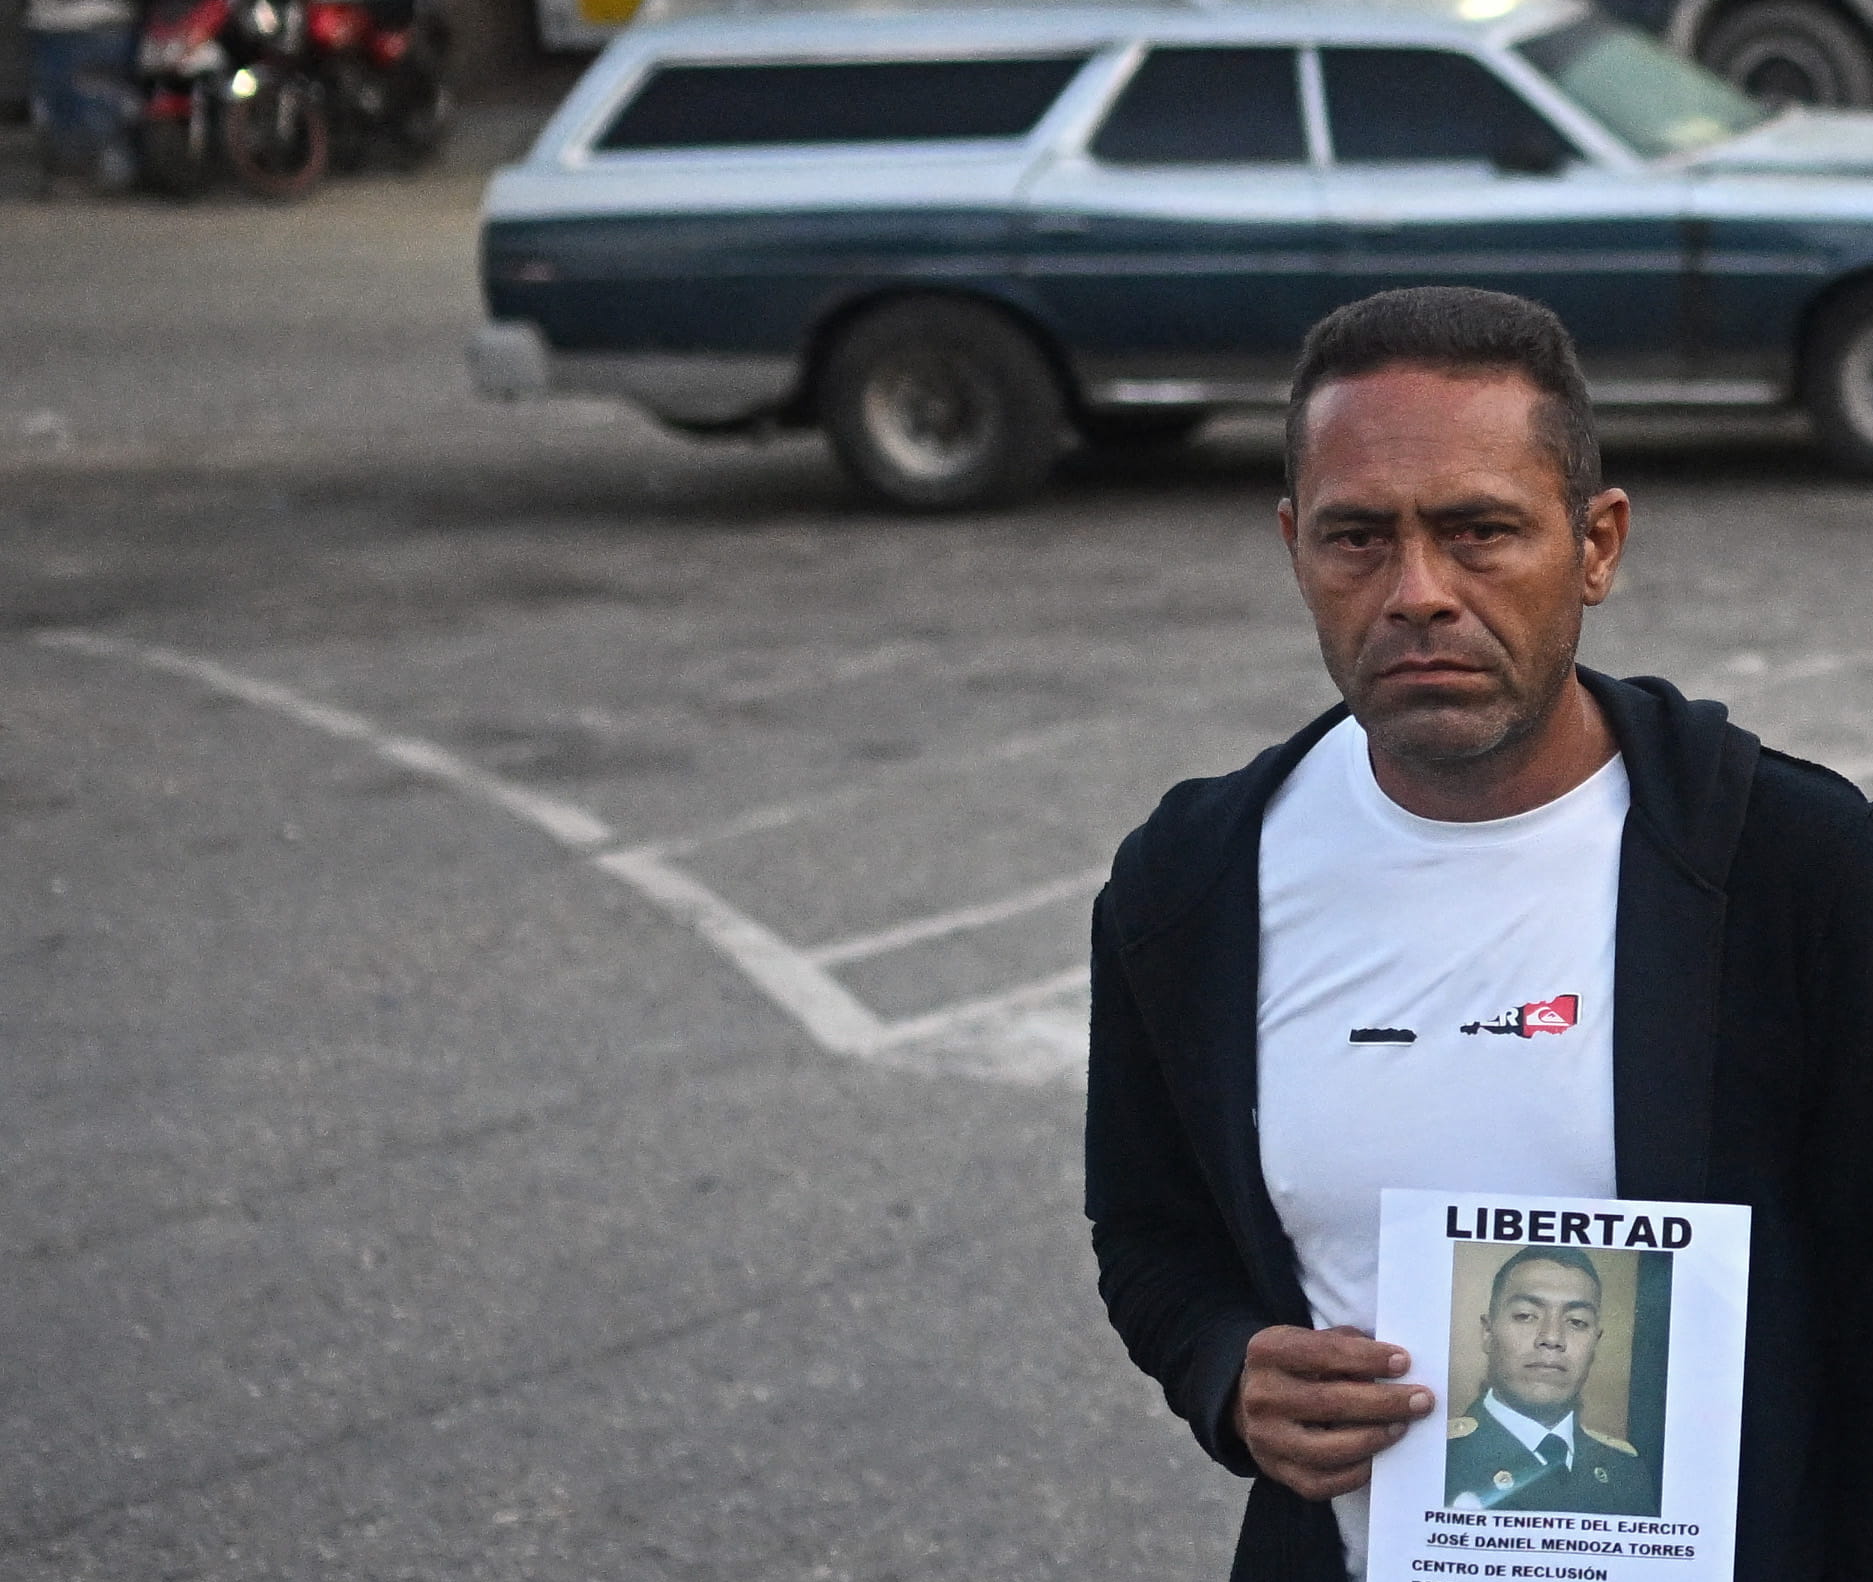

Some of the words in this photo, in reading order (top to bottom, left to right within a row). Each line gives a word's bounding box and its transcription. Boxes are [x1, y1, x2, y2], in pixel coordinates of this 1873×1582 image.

[1446, 1205, 1693, 1249] LIBERTAD
[1424, 1511, 1487, 1527] PRIMER
[1493, 1516, 1575, 1530] TENIENTE
[1581, 1519, 1612, 1532] DEL
[1618, 1521, 1700, 1536] EJERCITO
[1427, 1532, 1469, 1547] JOSÉ
[1475, 1536, 1536, 1550] DANIEL
[1541, 1538, 1623, 1554] MENDOZA
[1629, 1543, 1695, 1557] TORRES
[1411, 1559, 1479, 1576] CENTRO
[1484, 1564, 1506, 1577] DE
[1511, 1565, 1608, 1581] RECLUSIÓN
